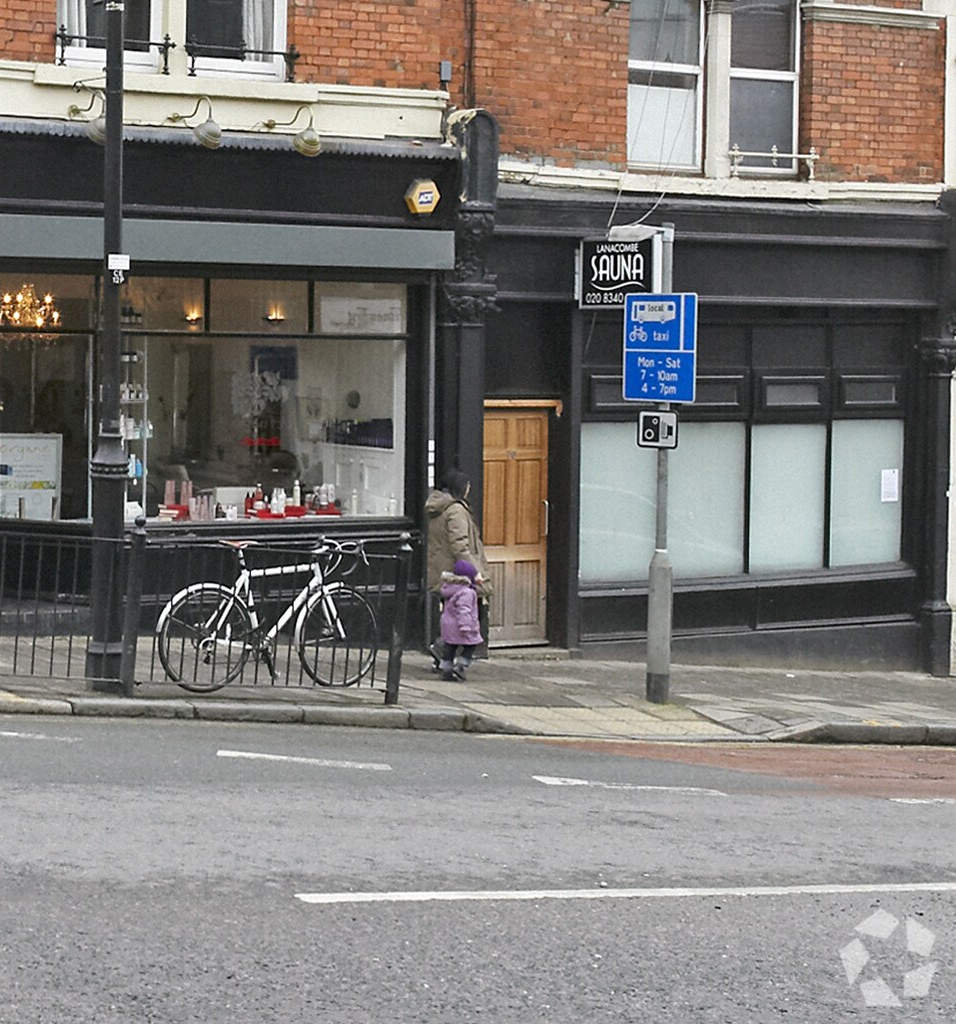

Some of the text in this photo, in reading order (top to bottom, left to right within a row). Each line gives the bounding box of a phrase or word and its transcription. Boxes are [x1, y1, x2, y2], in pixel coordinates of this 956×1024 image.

[596, 243, 639, 254] LANACOMBE
[591, 253, 644, 282] SAUNA
[585, 292, 624, 304] 020 8340
[647, 303, 664, 313] local
[653, 330, 670, 342] taxi
[637, 356, 655, 368] Mon
[665, 357, 681, 369] Sat
[641, 370, 646, 380] 7
[657, 370, 678, 382] 10am
[641, 383, 648, 393] 4
[659, 384, 677, 396] 7pm
